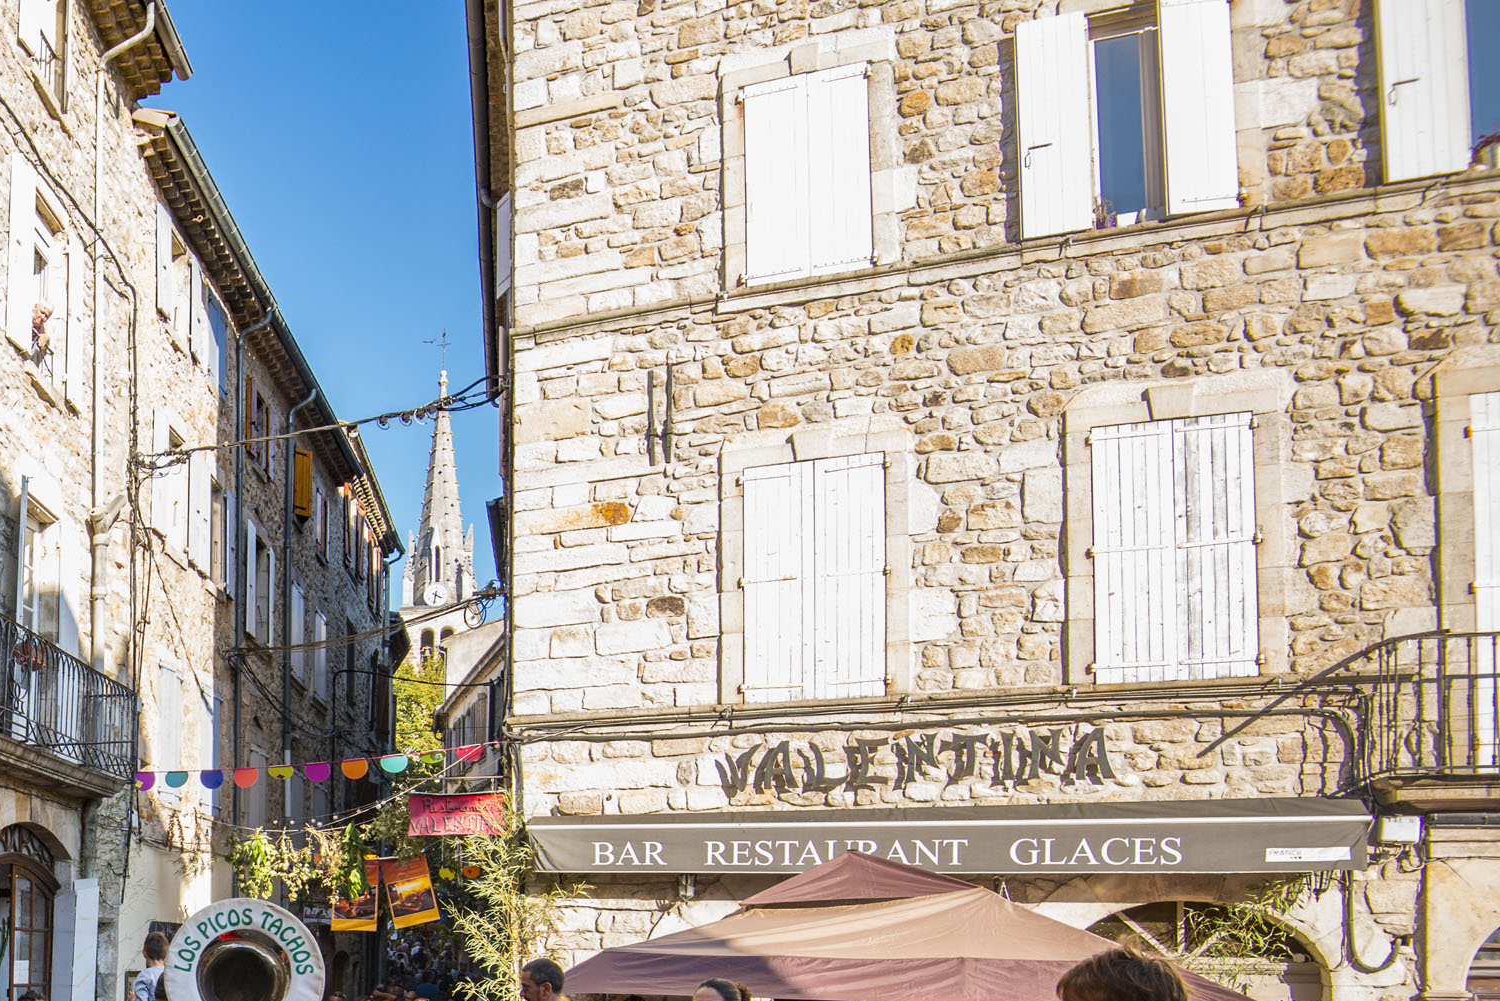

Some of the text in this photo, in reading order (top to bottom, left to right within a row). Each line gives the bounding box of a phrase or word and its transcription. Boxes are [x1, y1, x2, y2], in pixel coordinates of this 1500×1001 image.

[718, 727, 1117, 796] VALENTINA
[591, 841, 668, 866] BAR
[1009, 837, 1183, 866] GLACES
[174, 935, 202, 973] LOS
[196, 908, 253, 940] PICOS
[260, 911, 314, 975] TACHOS
